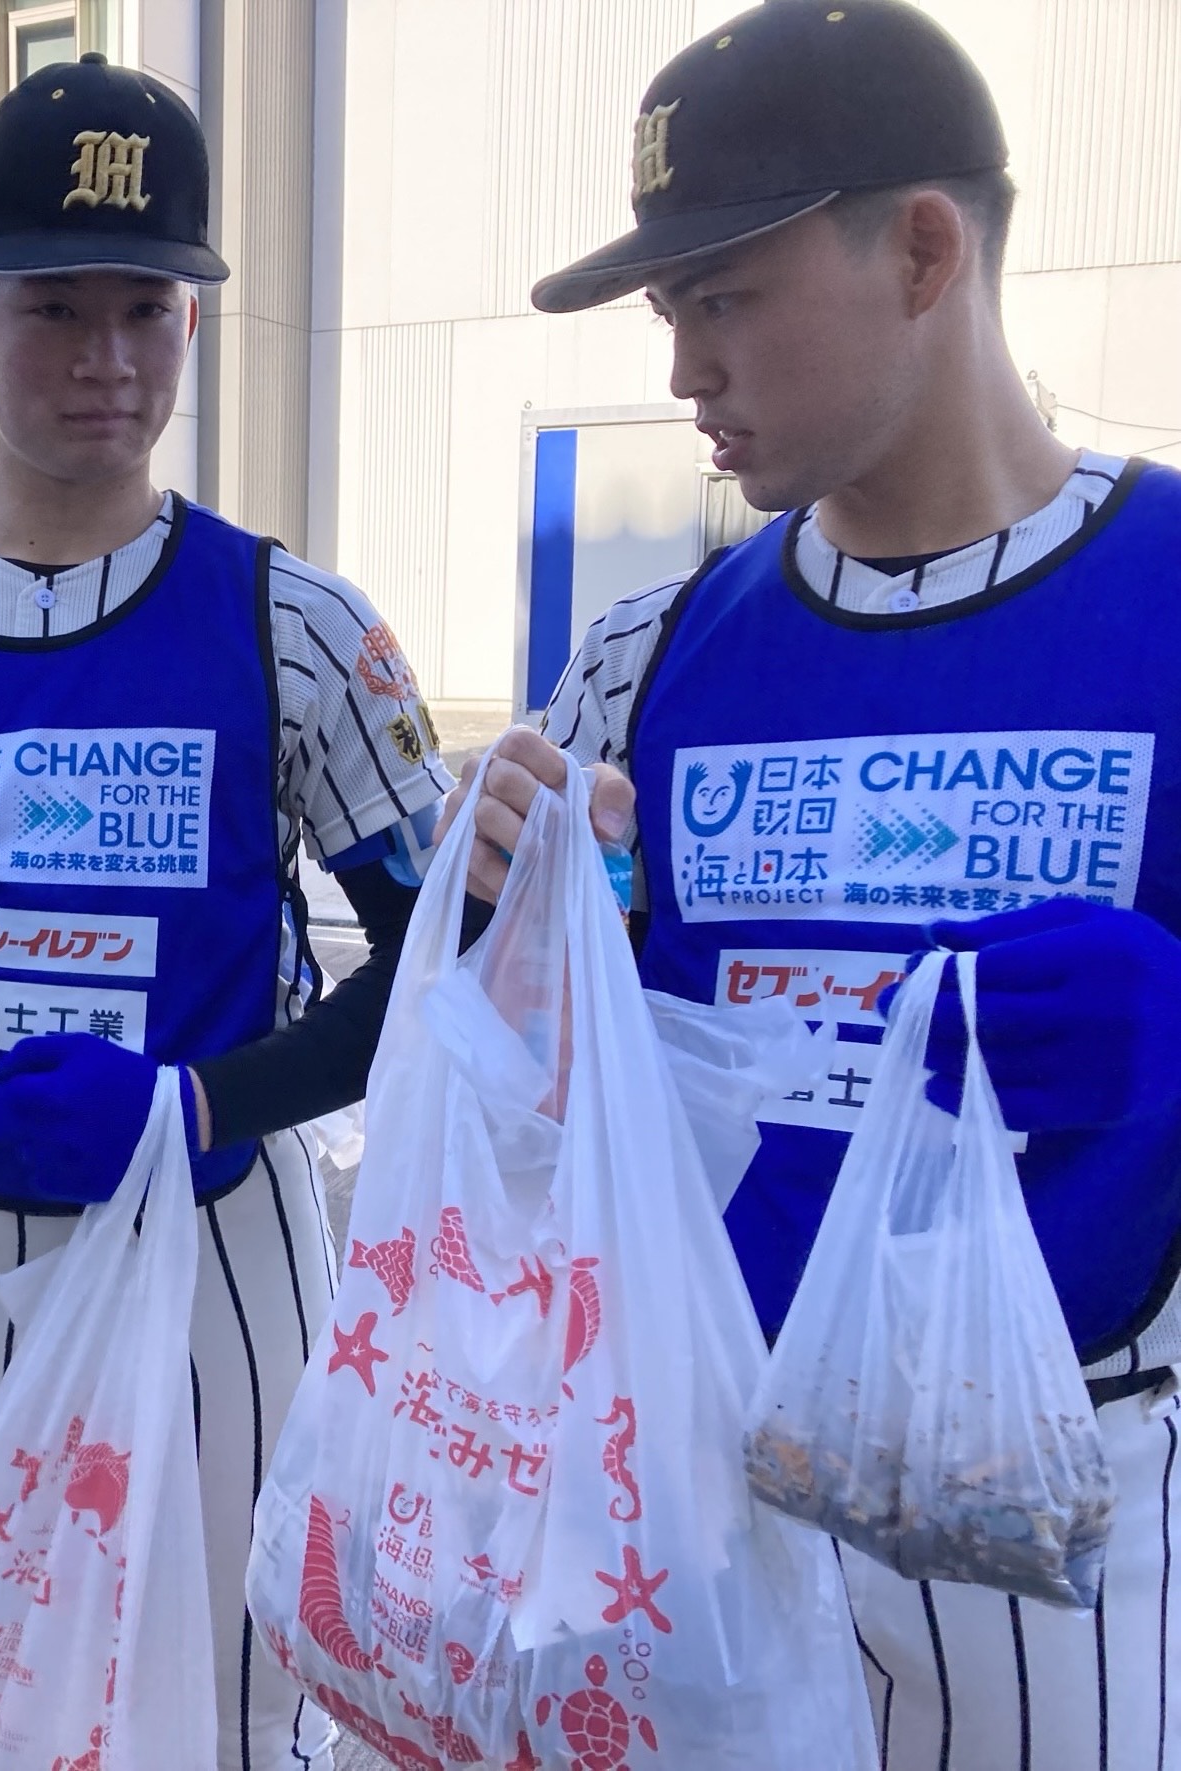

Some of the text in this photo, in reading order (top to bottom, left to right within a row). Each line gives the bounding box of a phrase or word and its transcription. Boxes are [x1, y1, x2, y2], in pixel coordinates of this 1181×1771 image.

[14, 741, 202, 778] CHANGE
[758, 755, 844, 793] 日本
[859, 748, 1133, 796] CHANGE
[101, 784, 200, 806] FOR THE
[99, 812, 199, 850] BLUE
[753, 797, 837, 836] 財団
[971, 801, 1127, 833] FOR THE
[9, 850, 198, 874] 海の未来を変える挑戦
[683, 843, 829, 907] 海と日本
[965, 834, 1123, 888] BLUE
[732, 887, 825, 905] PROJECT
[843, 882, 1114, 912] 海の未来を変え
